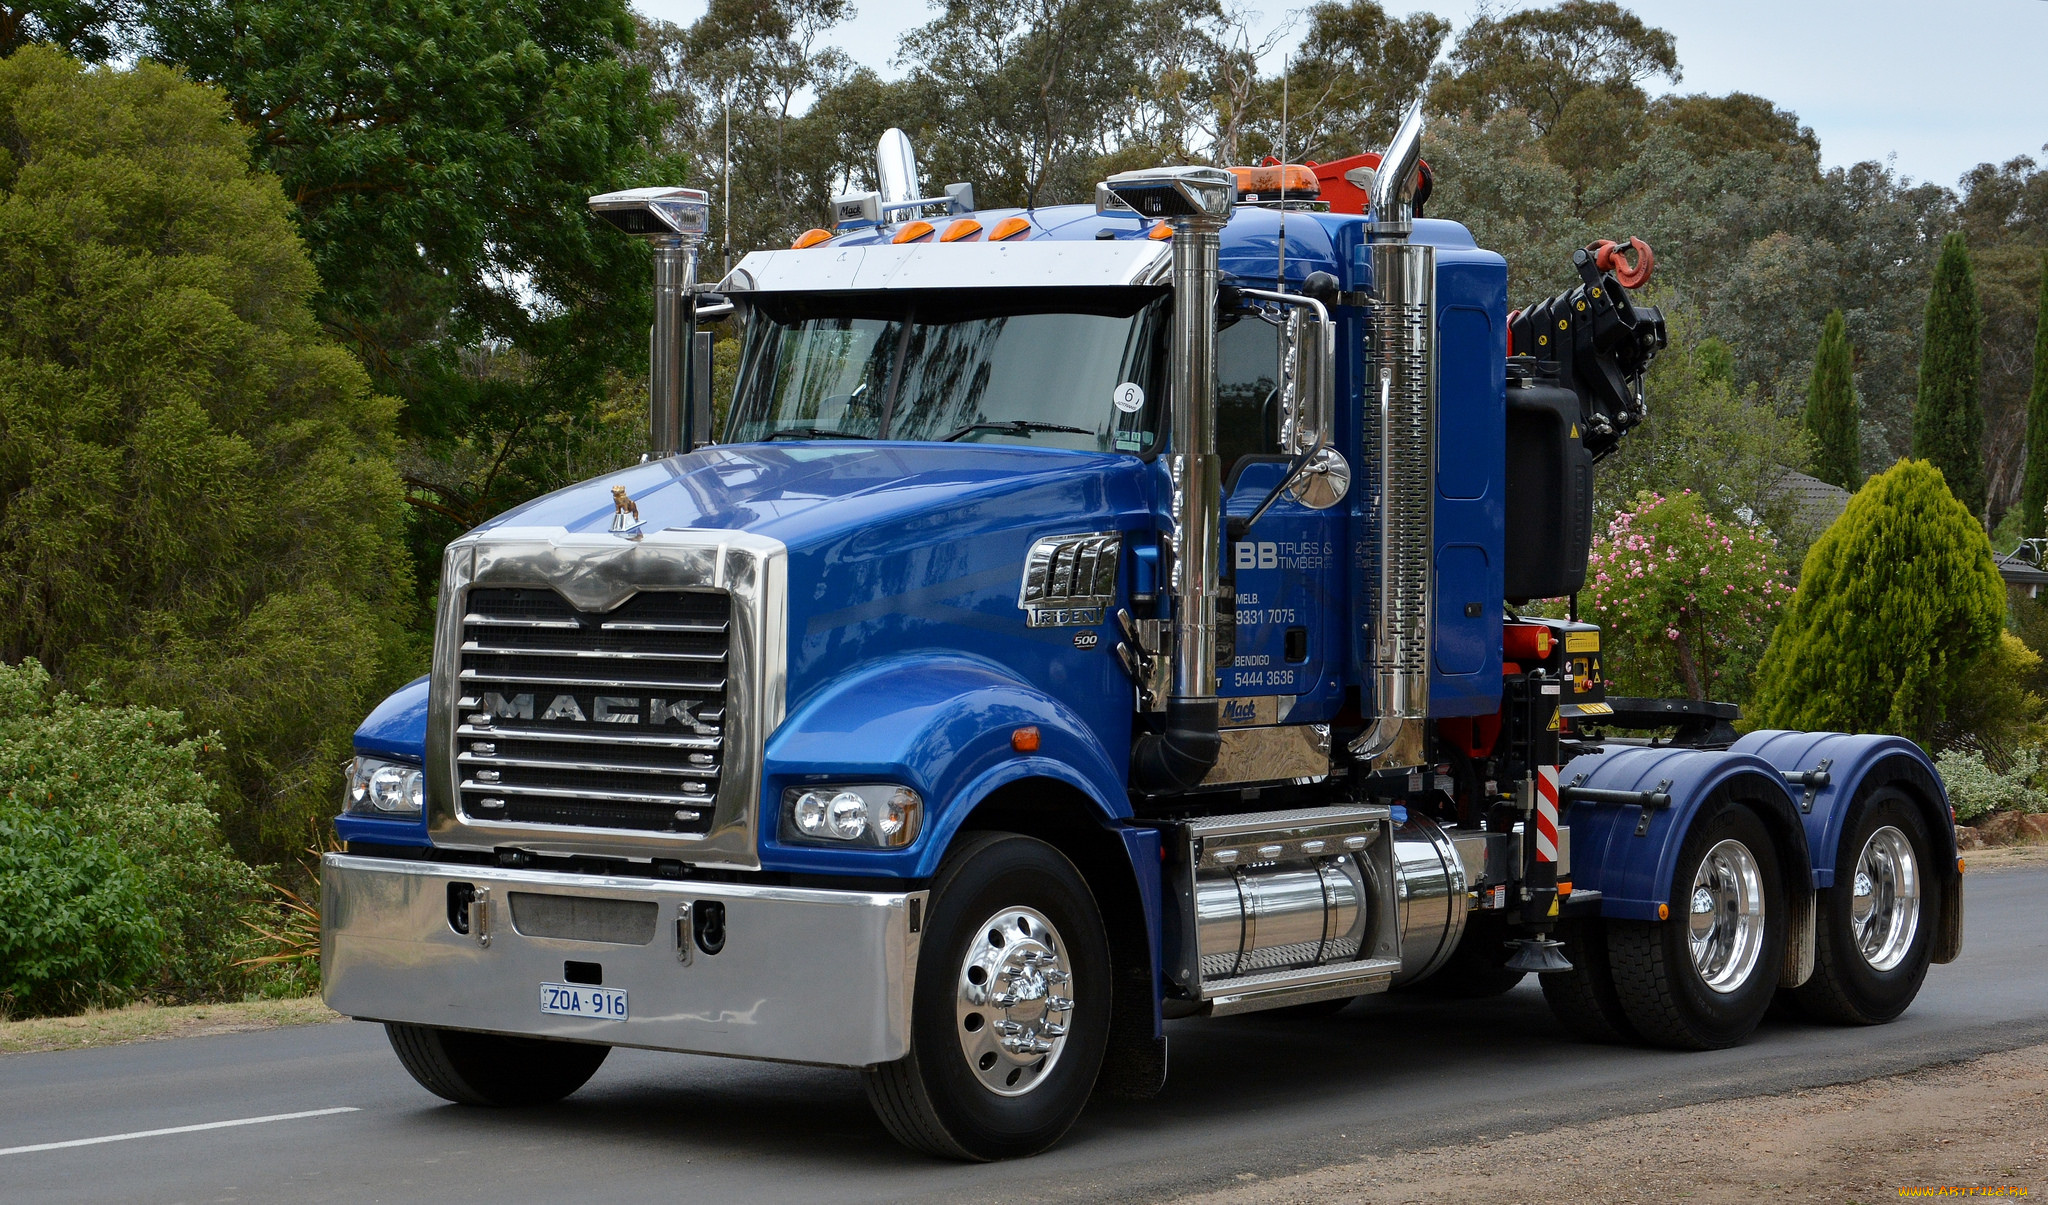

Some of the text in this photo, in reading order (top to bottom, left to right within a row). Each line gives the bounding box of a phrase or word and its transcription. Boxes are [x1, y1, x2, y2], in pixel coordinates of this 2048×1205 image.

[840, 204, 862, 217] Mack
[1125, 388, 1134, 402] 6
[1278, 542, 1333, 555] TRUSS &
[1235, 542, 1278, 569] BB
[1278, 556, 1323, 569] TIMBER
[1236, 593, 1260, 605] MELB.
[1235, 608, 1295, 625] 9331 7075
[1074, 635, 1098, 645] 500
[1235, 654, 1270, 667] BENDIGO
[1235, 672, 1263, 687] 5444
[1266, 670, 1294, 685] 3636
[483, 692, 703, 728] MACK
[1222, 700, 1256, 722] Mack
